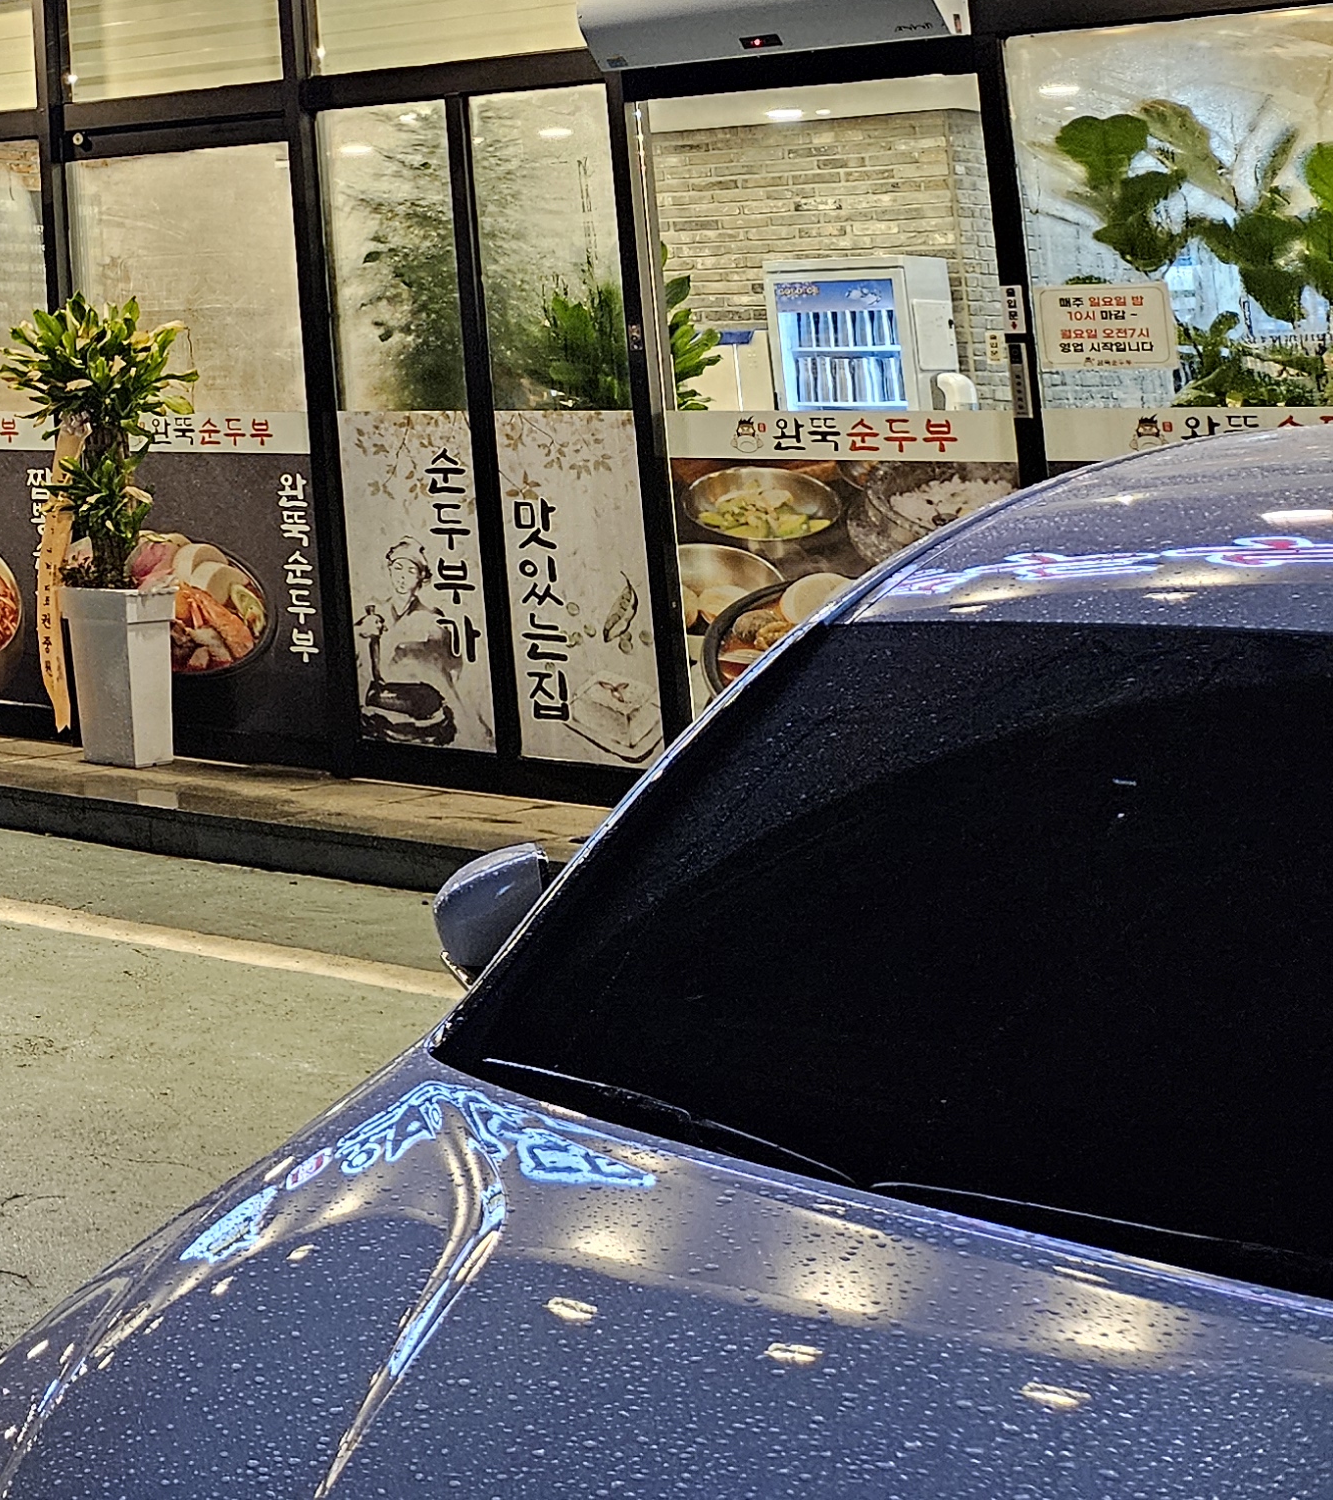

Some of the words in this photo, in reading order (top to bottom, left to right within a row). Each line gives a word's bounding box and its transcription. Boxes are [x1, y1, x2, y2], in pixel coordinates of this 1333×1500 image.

[1058, 297, 1084, 308] 매주
[1088, 296, 1127, 307] 일요일
[1067, 310, 1096, 321] 10시
[1100, 310, 1126, 320] 마감
[1059, 342, 1084, 352] 영업
[1089, 341, 1154, 352] 시작입니다
[1061, 328, 1098, 339] 월요일
[1102, 327, 1150, 339] 오전7시
[151, 417, 274, 446] 완뚝순두부
[771, 417, 959, 453] 완뚝순두부
[277, 472, 321, 664] 완뚝순두부
[424, 447, 481, 664] 순두부가
[513, 497, 571, 722] 맛있는집
